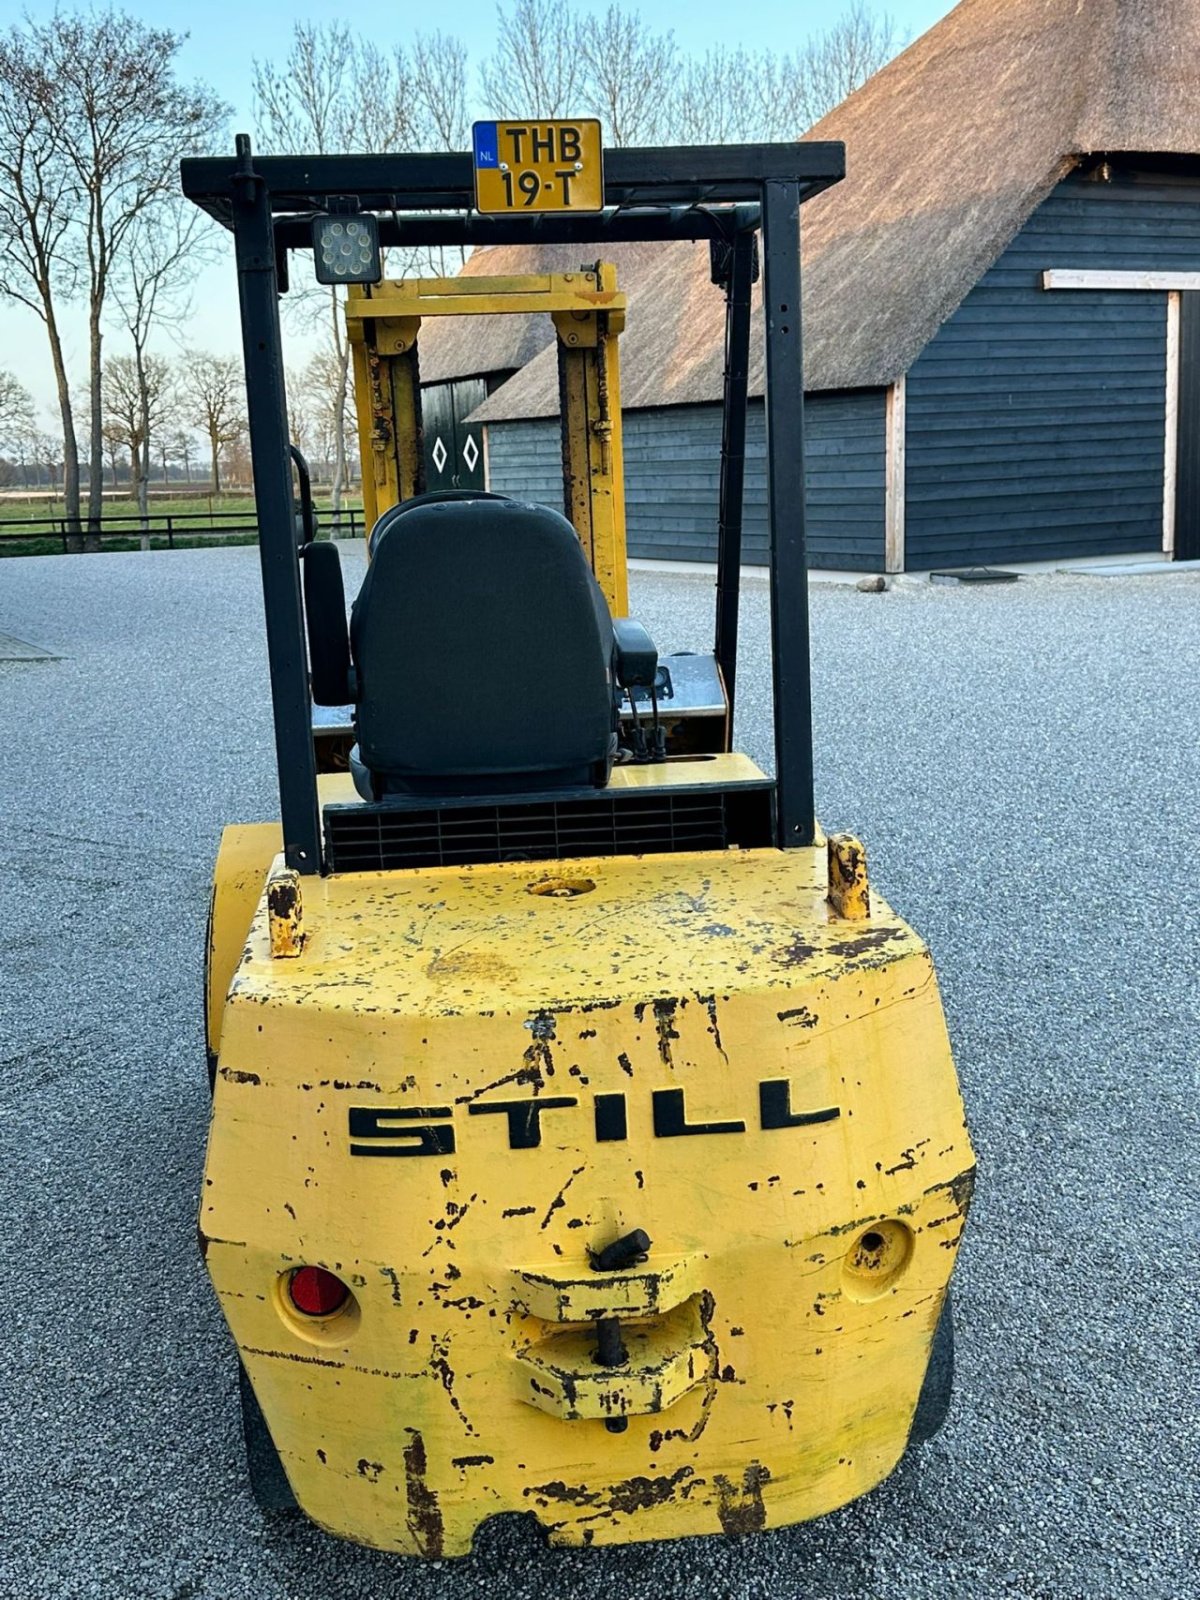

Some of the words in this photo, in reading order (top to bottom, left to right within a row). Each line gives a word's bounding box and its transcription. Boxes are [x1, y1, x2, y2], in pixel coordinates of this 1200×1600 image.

[480, 151, 494, 162] NL
[506, 128, 581, 163] THB
[502, 171, 576, 207] 19-T
[349, 1079, 840, 1157] STILL
